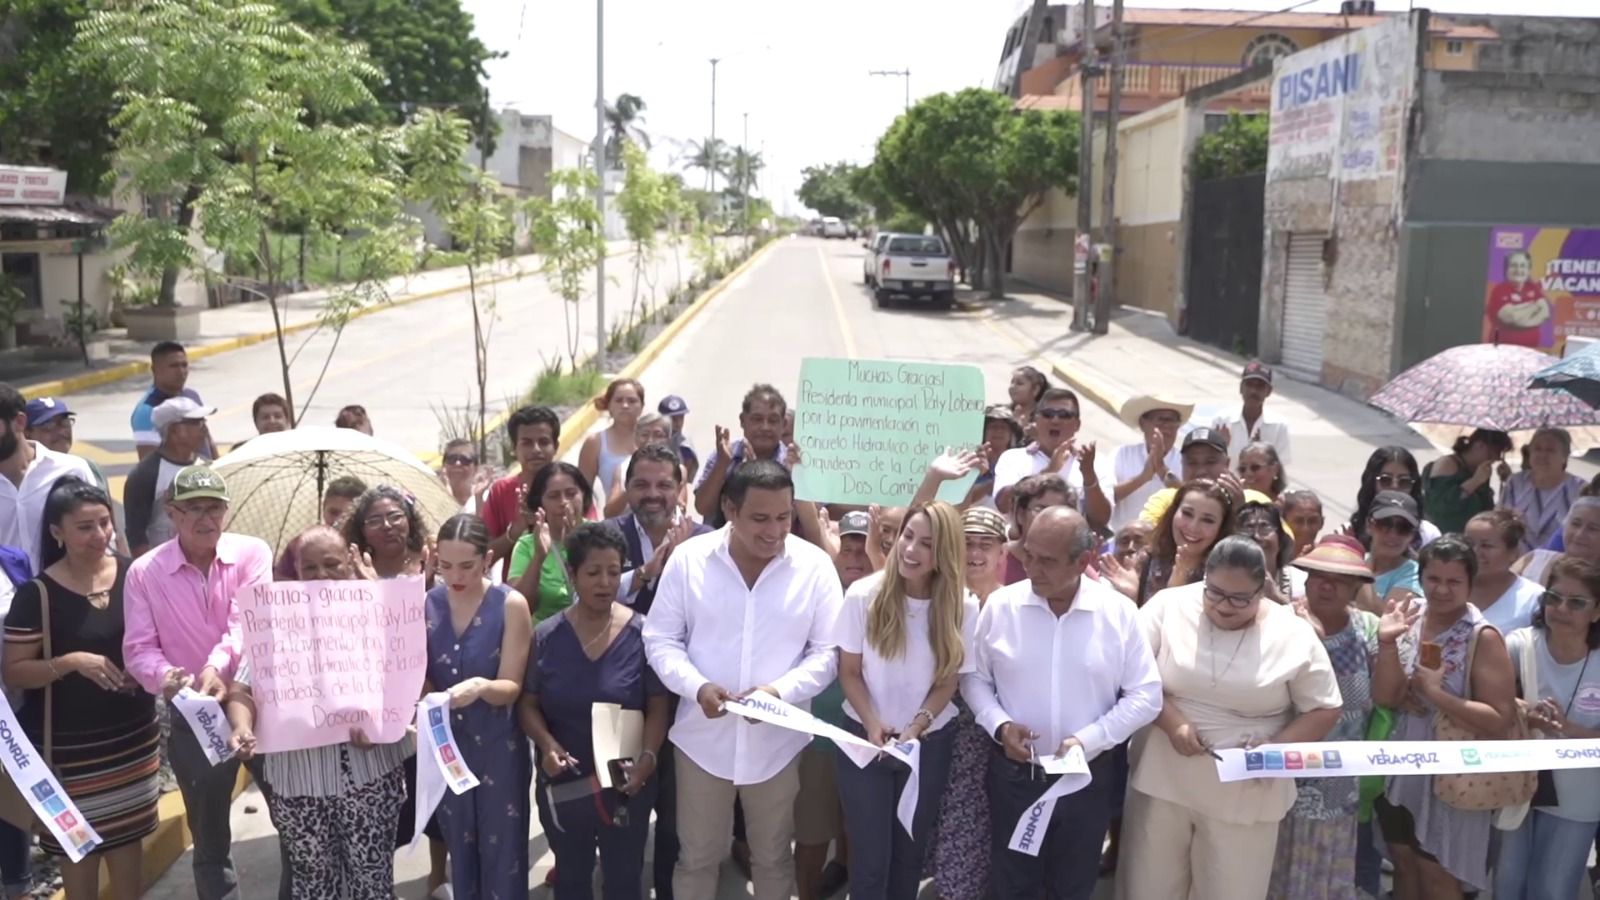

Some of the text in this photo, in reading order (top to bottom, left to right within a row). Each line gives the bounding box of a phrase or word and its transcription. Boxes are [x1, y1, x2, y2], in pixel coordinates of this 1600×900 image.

[1279, 54, 1359, 109] PISANI
[1546, 259, 1600, 275] ¡TENE
[802, 410, 821, 430] por
[826, 409, 836, 426] la
[926, 421, 940, 436] en
[913, 439, 929, 455] de
[869, 456, 884, 472] de
[842, 473, 873, 495] Dos
[390, 635, 406, 652] en
